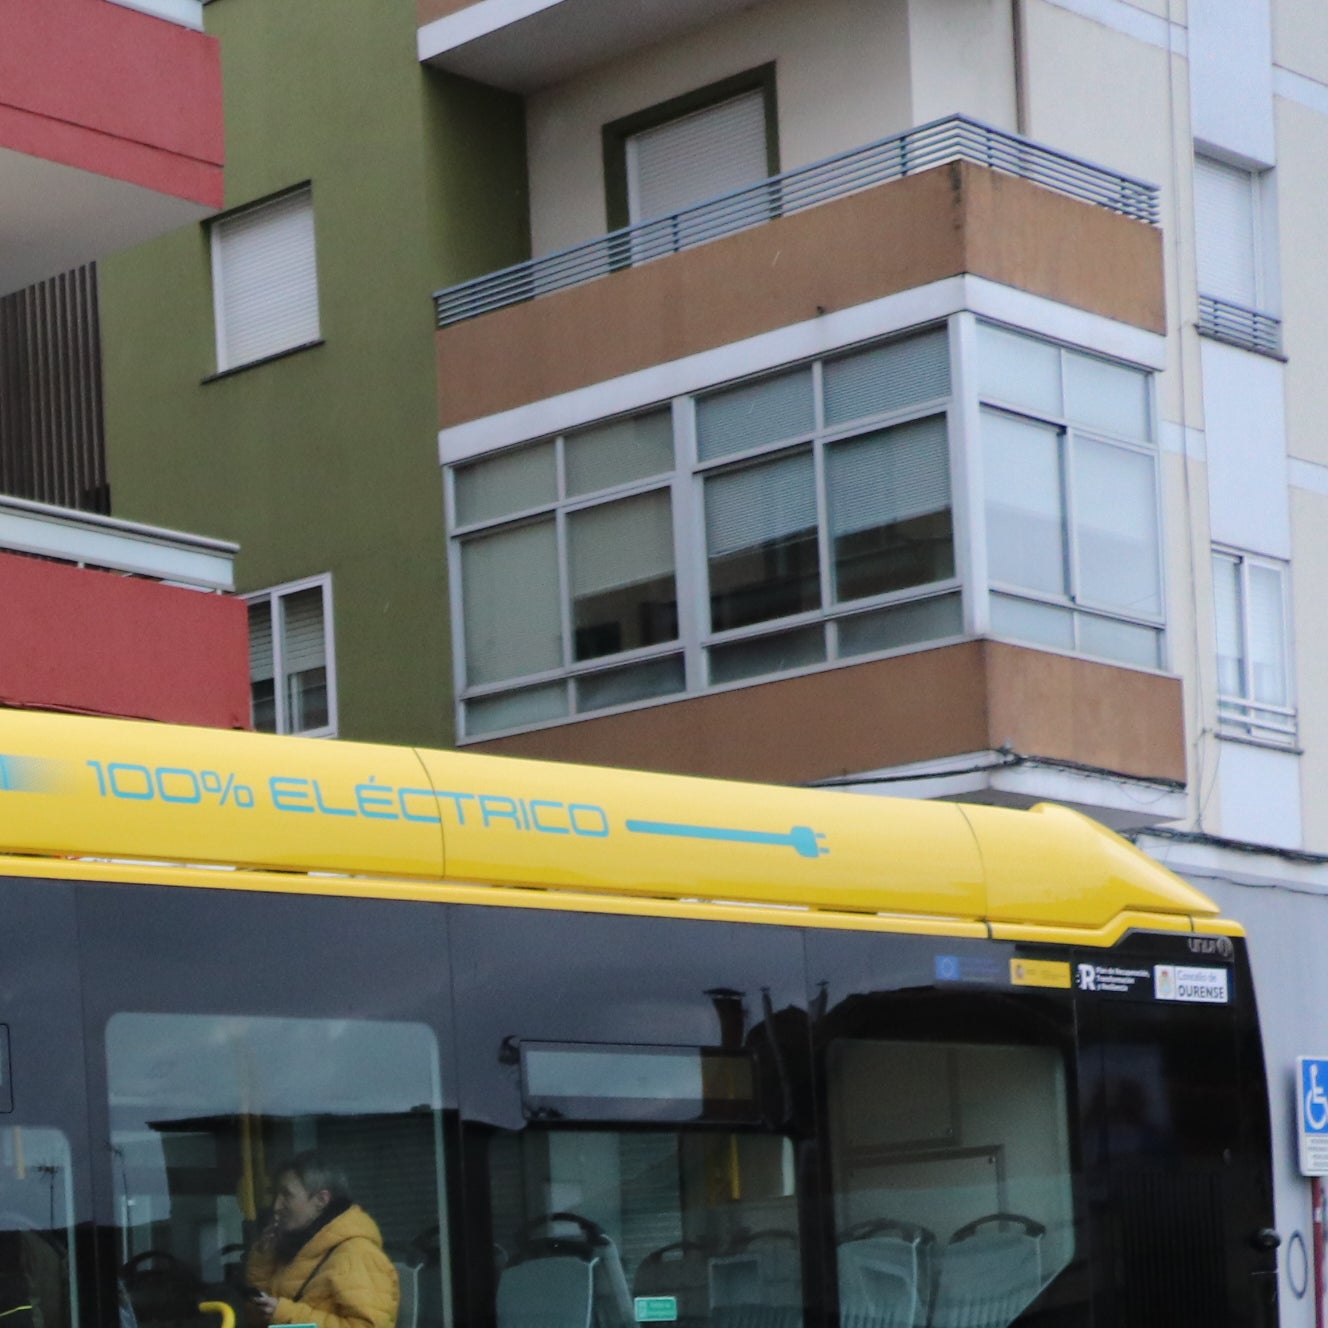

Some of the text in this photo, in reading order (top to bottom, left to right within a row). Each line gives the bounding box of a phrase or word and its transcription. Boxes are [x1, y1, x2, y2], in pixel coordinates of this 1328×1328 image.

[86, 759, 254, 809] 100%
[268, 773, 610, 838] ELÉCTRICO
[1178, 984, 1225, 999] OURENSE
